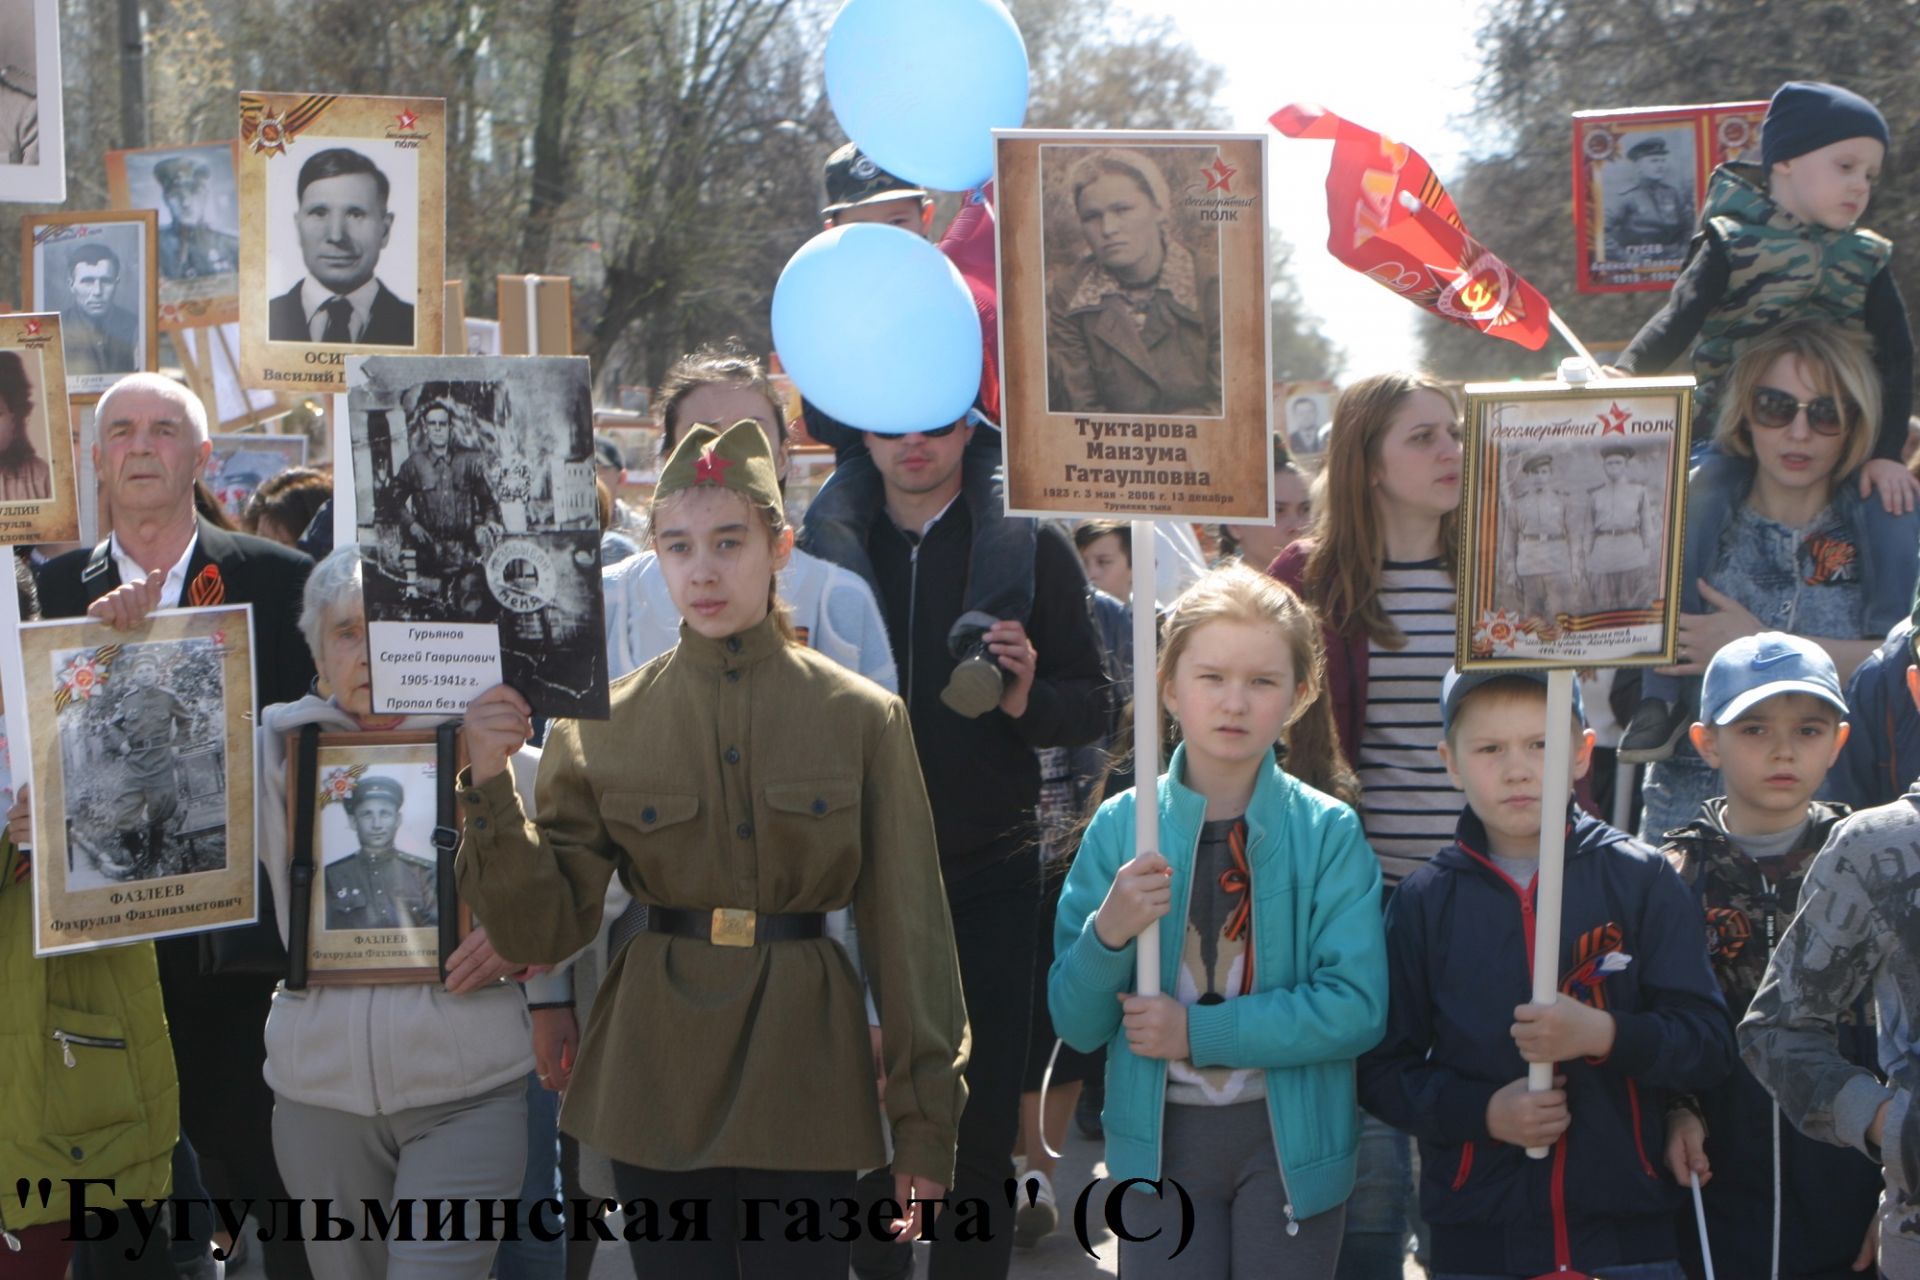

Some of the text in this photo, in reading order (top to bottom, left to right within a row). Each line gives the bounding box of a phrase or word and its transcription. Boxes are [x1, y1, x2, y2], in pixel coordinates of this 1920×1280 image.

[1200, 210, 1238, 221] ПОЛК
[263, 369, 334, 383] Василий
[1075, 418, 1197, 441] Туктарова
[1491, 405, 1599, 442] бессмертный
[1087, 442, 1187, 465] Манзума
[1065, 464, 1210, 488] Гатаулловна
[1096, 491, 1116, 499] мая
[409, 628, 464, 641] Гурьянов
[380, 651, 496, 664] Сергей Гаврилович
[387, 698, 432, 710] Пропал
[436, 697, 456, 709] без
[110, 884, 185, 905] ФАЗЛЕЕВ
